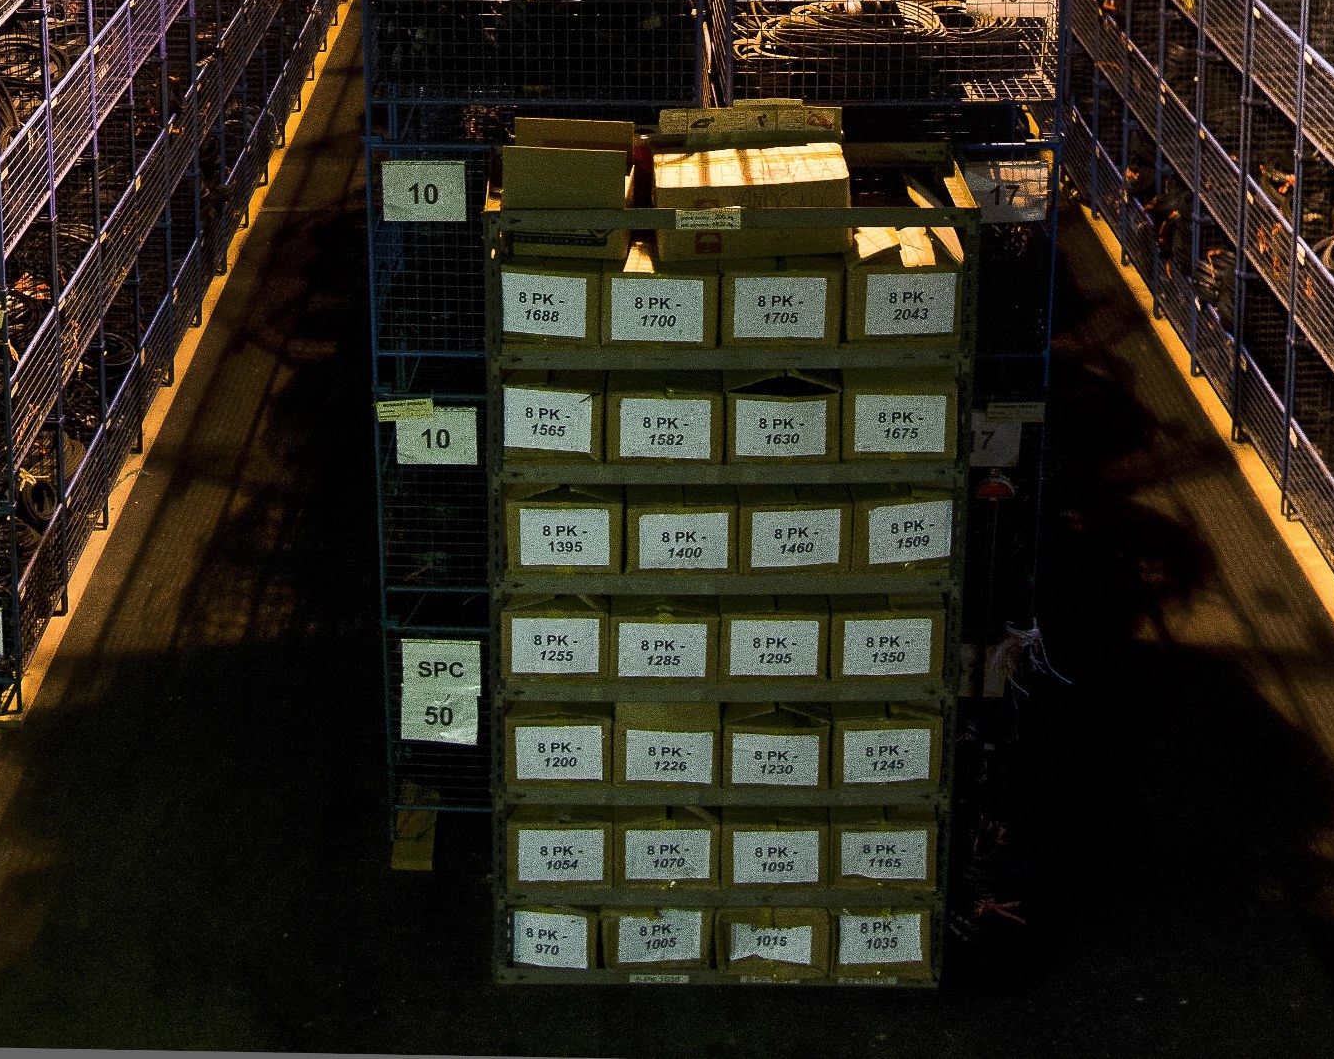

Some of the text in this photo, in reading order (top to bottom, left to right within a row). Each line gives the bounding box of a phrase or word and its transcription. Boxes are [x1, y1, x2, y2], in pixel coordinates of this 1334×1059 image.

[408, 184, 438, 204] 10
[990, 185, 1019, 206] 17
[519, 291, 527, 303] 8
[757, 295, 766, 308] 8
[889, 292, 897, 304] 8
[634, 297, 643, 310] 8
[525, 309, 559, 323] 1688
[764, 312, 798, 324] 1705
[893, 307, 929, 321] 2043
[641, 314, 677, 328] 1700
[525, 407, 534, 419] 8
[878, 412, 887, 423] 8
[531, 423, 566, 437] 1565
[884, 427, 919, 439] 1675
[421, 429, 450, 449] 10
[542, 525, 551, 537] 8
[549, 541, 583, 553] 1395
[533, 634, 542, 646] 8
[753, 637, 761, 649] 8
[866, 637, 875, 648] 8
[540, 650, 574, 662] 1255
[759, 653, 793, 665] 1295
[872, 651, 906, 663] 1350
[418, 662, 464, 678] SPC
[425, 706, 453, 725] 50
[537, 742, 546, 754] 8
[648, 746, 656, 757] 8
[544, 757, 577, 768] 1200
[654, 761, 687, 772] 1226
[755, 847, 763, 858] 8
[761, 860, 794, 873] 1095
